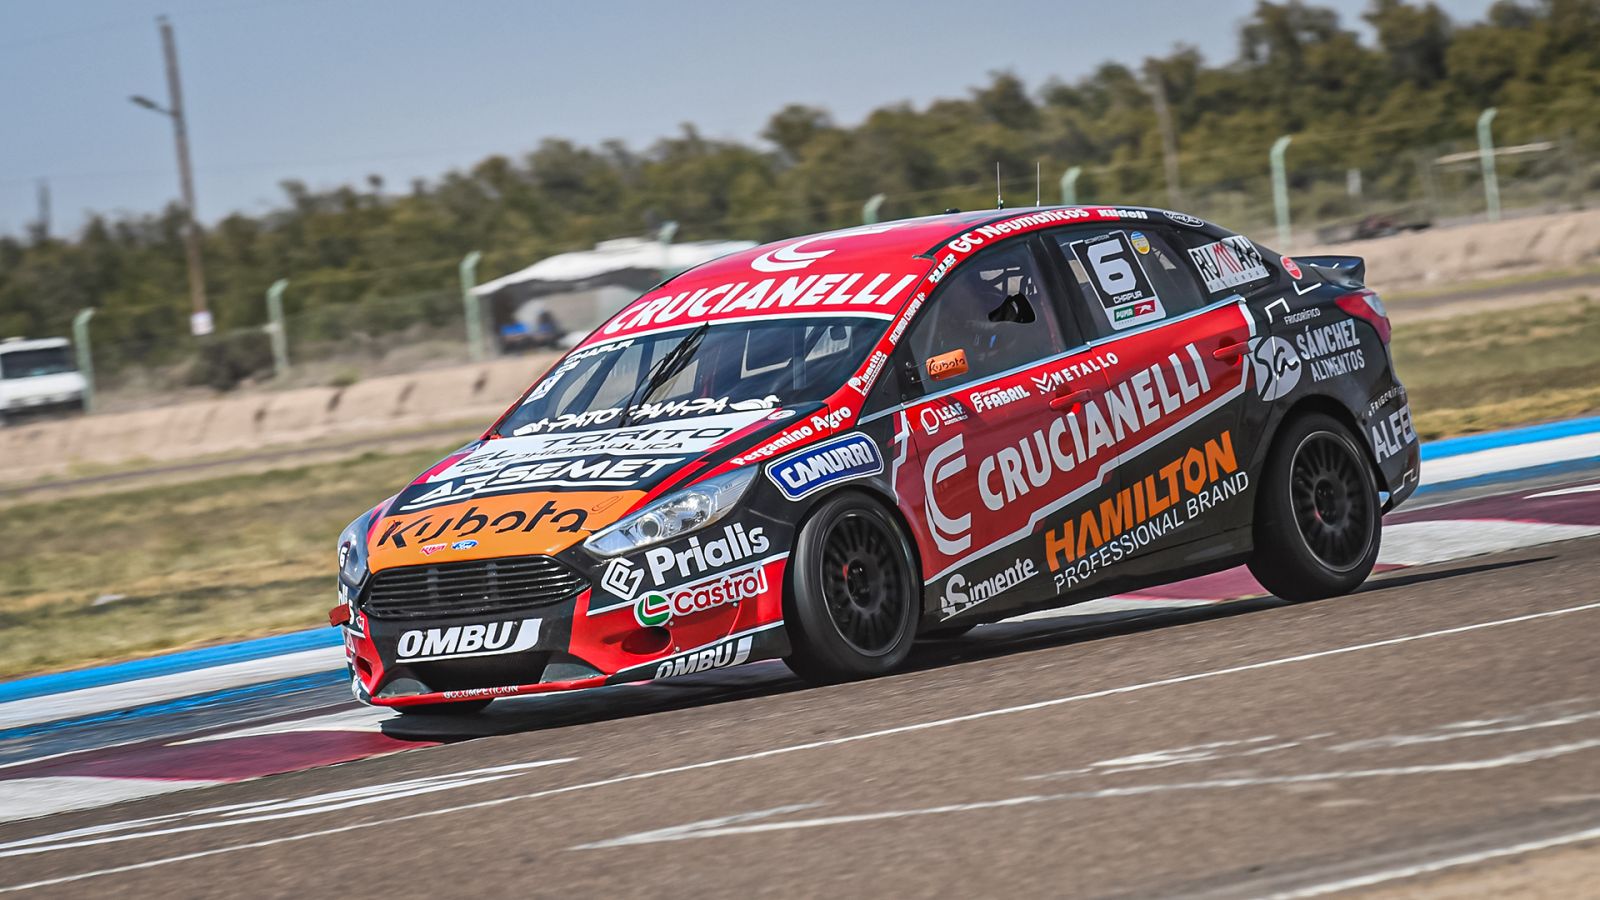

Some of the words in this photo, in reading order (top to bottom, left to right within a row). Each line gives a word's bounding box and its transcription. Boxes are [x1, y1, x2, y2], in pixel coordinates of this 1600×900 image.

[949, 230, 984, 254] GC
[1087, 238, 1137, 296] 6
[603, 272, 918, 335] CRUCIANELLI
[1112, 290, 1143, 304] CHAPUR
[1296, 318, 1361, 361] SÁNCHEZ
[1053, 352, 1119, 385] METALLO
[1310, 349, 1366, 383] ALIMENTOS
[938, 402, 963, 421] LEAF
[986, 384, 1031, 410] FABRIL
[543, 428, 734, 449] TORITO
[730, 425, 813, 467] Pergamino
[811, 406, 852, 431] Agro
[978, 343, 1211, 512] CRUCIANELLI
[780, 441, 875, 489] CAMURRI
[1045, 430, 1238, 573] HAMILTON
[376, 500, 589, 549] Kubota
[1054, 508, 1185, 595] PROFESSIONAL
[1186, 471, 1250, 520] BRAND
[645, 522, 770, 586] Prialis
[674, 567, 765, 614] Castrol
[397, 620, 514, 658] OMBU
[655, 641, 733, 680] OMBU
